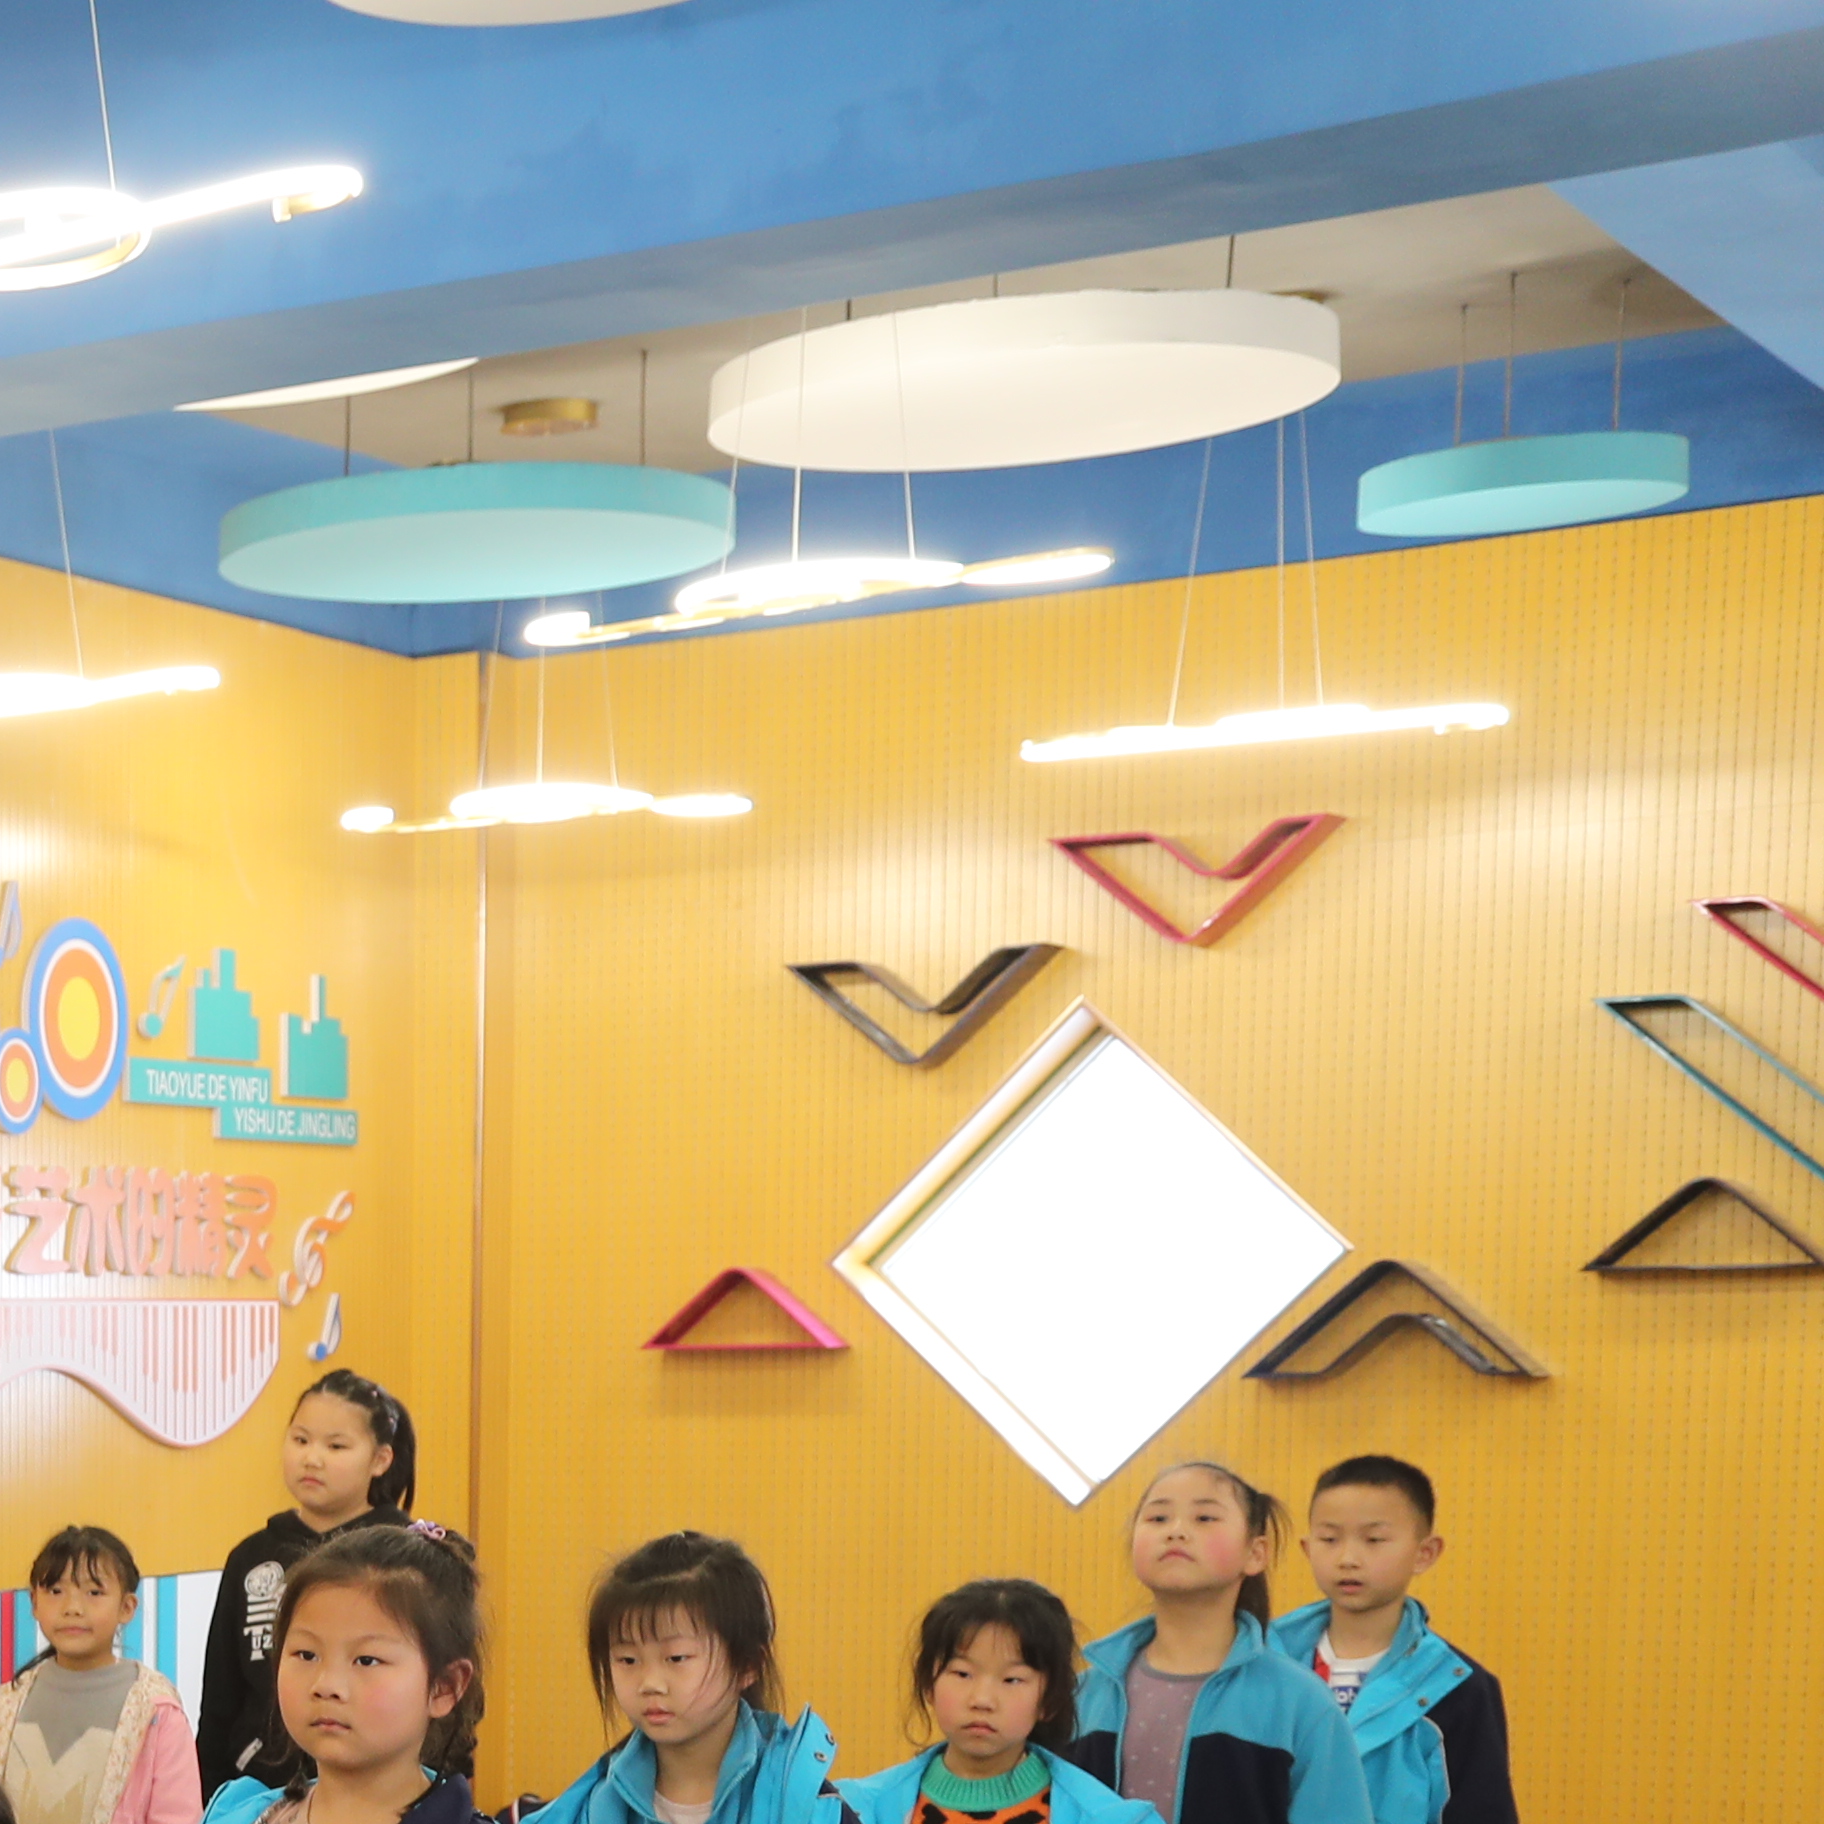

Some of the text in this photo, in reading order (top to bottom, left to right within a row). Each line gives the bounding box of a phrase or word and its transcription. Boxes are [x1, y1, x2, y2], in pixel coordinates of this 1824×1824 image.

[146, 1068, 269, 1104] TIAOYUE DE YINFU
[233, 1107, 356, 1140] YISHU DE JINGLING
